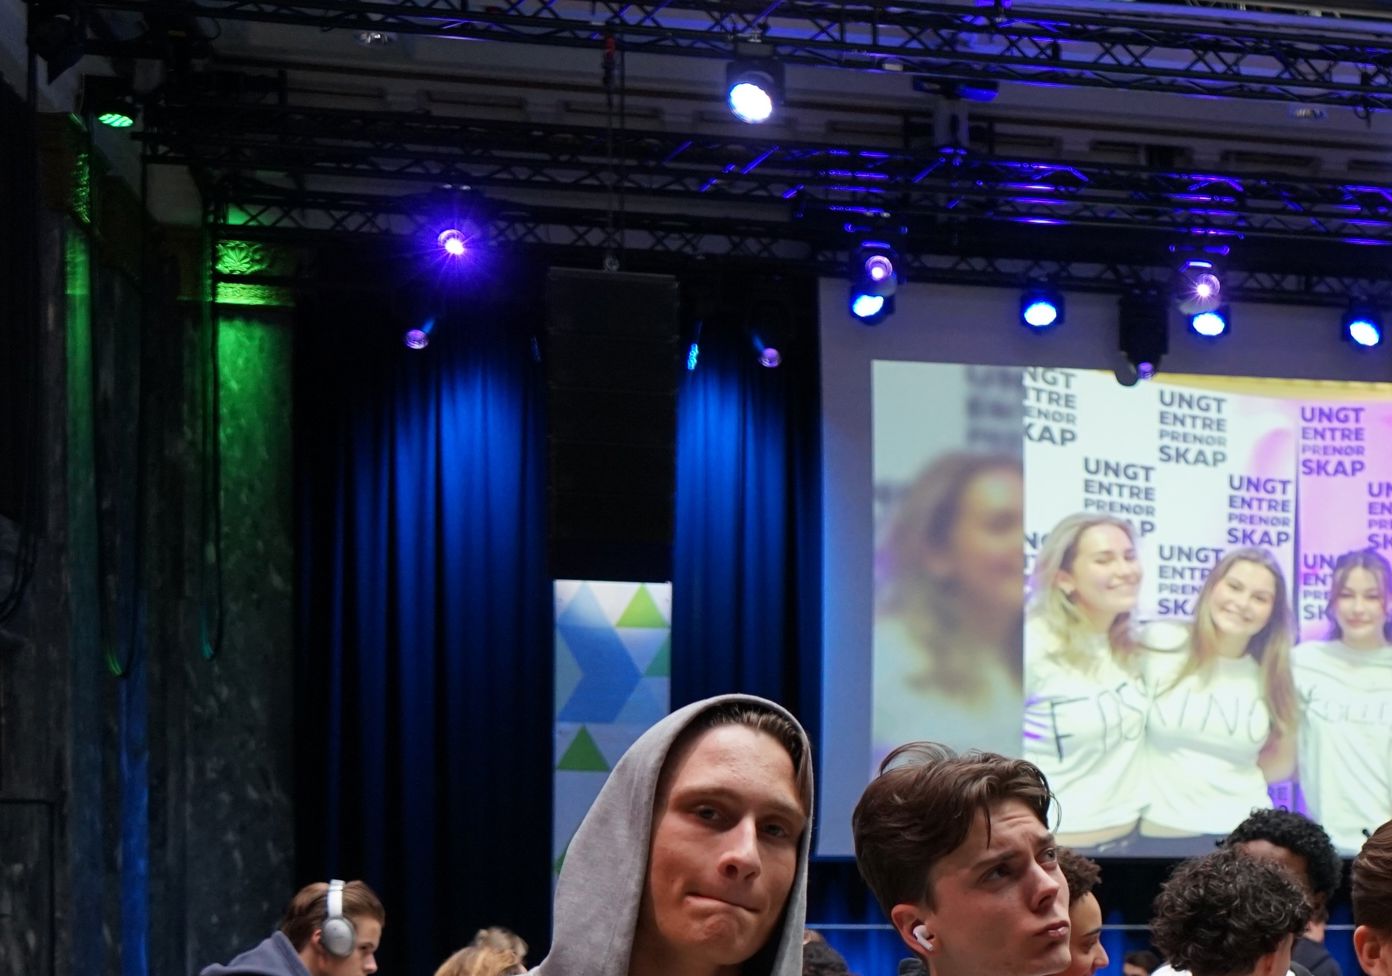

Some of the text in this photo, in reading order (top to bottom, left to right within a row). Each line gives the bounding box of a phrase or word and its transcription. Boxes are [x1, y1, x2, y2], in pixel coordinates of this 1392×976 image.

[1024, 368, 1077, 390] NGT
[1024, 387, 1077, 410] TRE
[1159, 390, 1227, 414] UNGT
[1159, 411, 1227, 432] ENTRE
[1301, 406, 1365, 424] UNGT
[1024, 422, 1077, 447] KAP
[1301, 427, 1365, 441] ENTRE
[1159, 445, 1228, 467] SKAP
[1084, 457, 1156, 483] UNGT
[1301, 459, 1365, 477] SKAP
[1084, 479, 1156, 501] ENTRE
[1229, 474, 1291, 495] UNGT
[1228, 494, 1290, 513] ENTRE
[1227, 527, 1289, 547] SKAP
[1159, 544, 1224, 564] UNGT
[1303, 553, 1336, 570] UN
[1158, 564, 1212, 581] ENTR
[1158, 598, 1194, 616] SK
